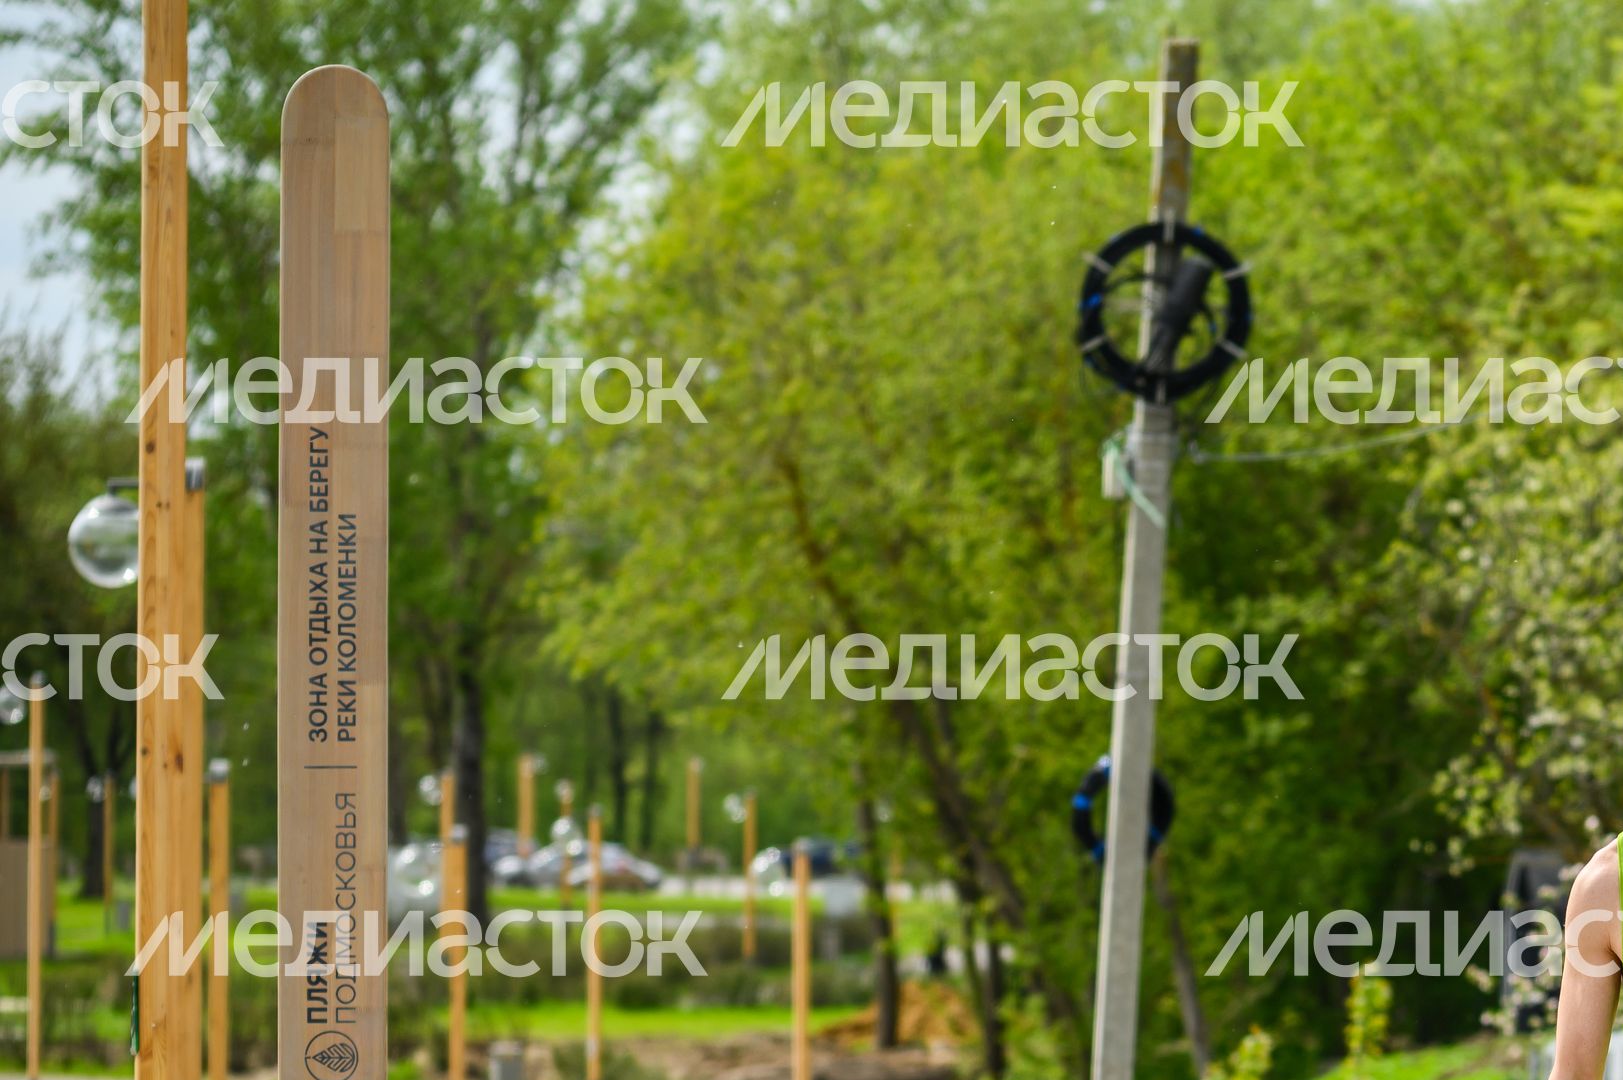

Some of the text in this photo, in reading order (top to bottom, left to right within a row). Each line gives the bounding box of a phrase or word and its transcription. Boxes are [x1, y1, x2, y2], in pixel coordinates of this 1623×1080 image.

[308, 426, 331, 743] ЗОНА ОТДЫХА НА БЕРЕГУ
[337, 514, 356, 741] РЕКИ КОЛОМЕНКИ
[307, 922, 328, 1024] ПЛЯЖИ
[335, 793, 357, 1024] ПОДМОСКОВЬЯ
